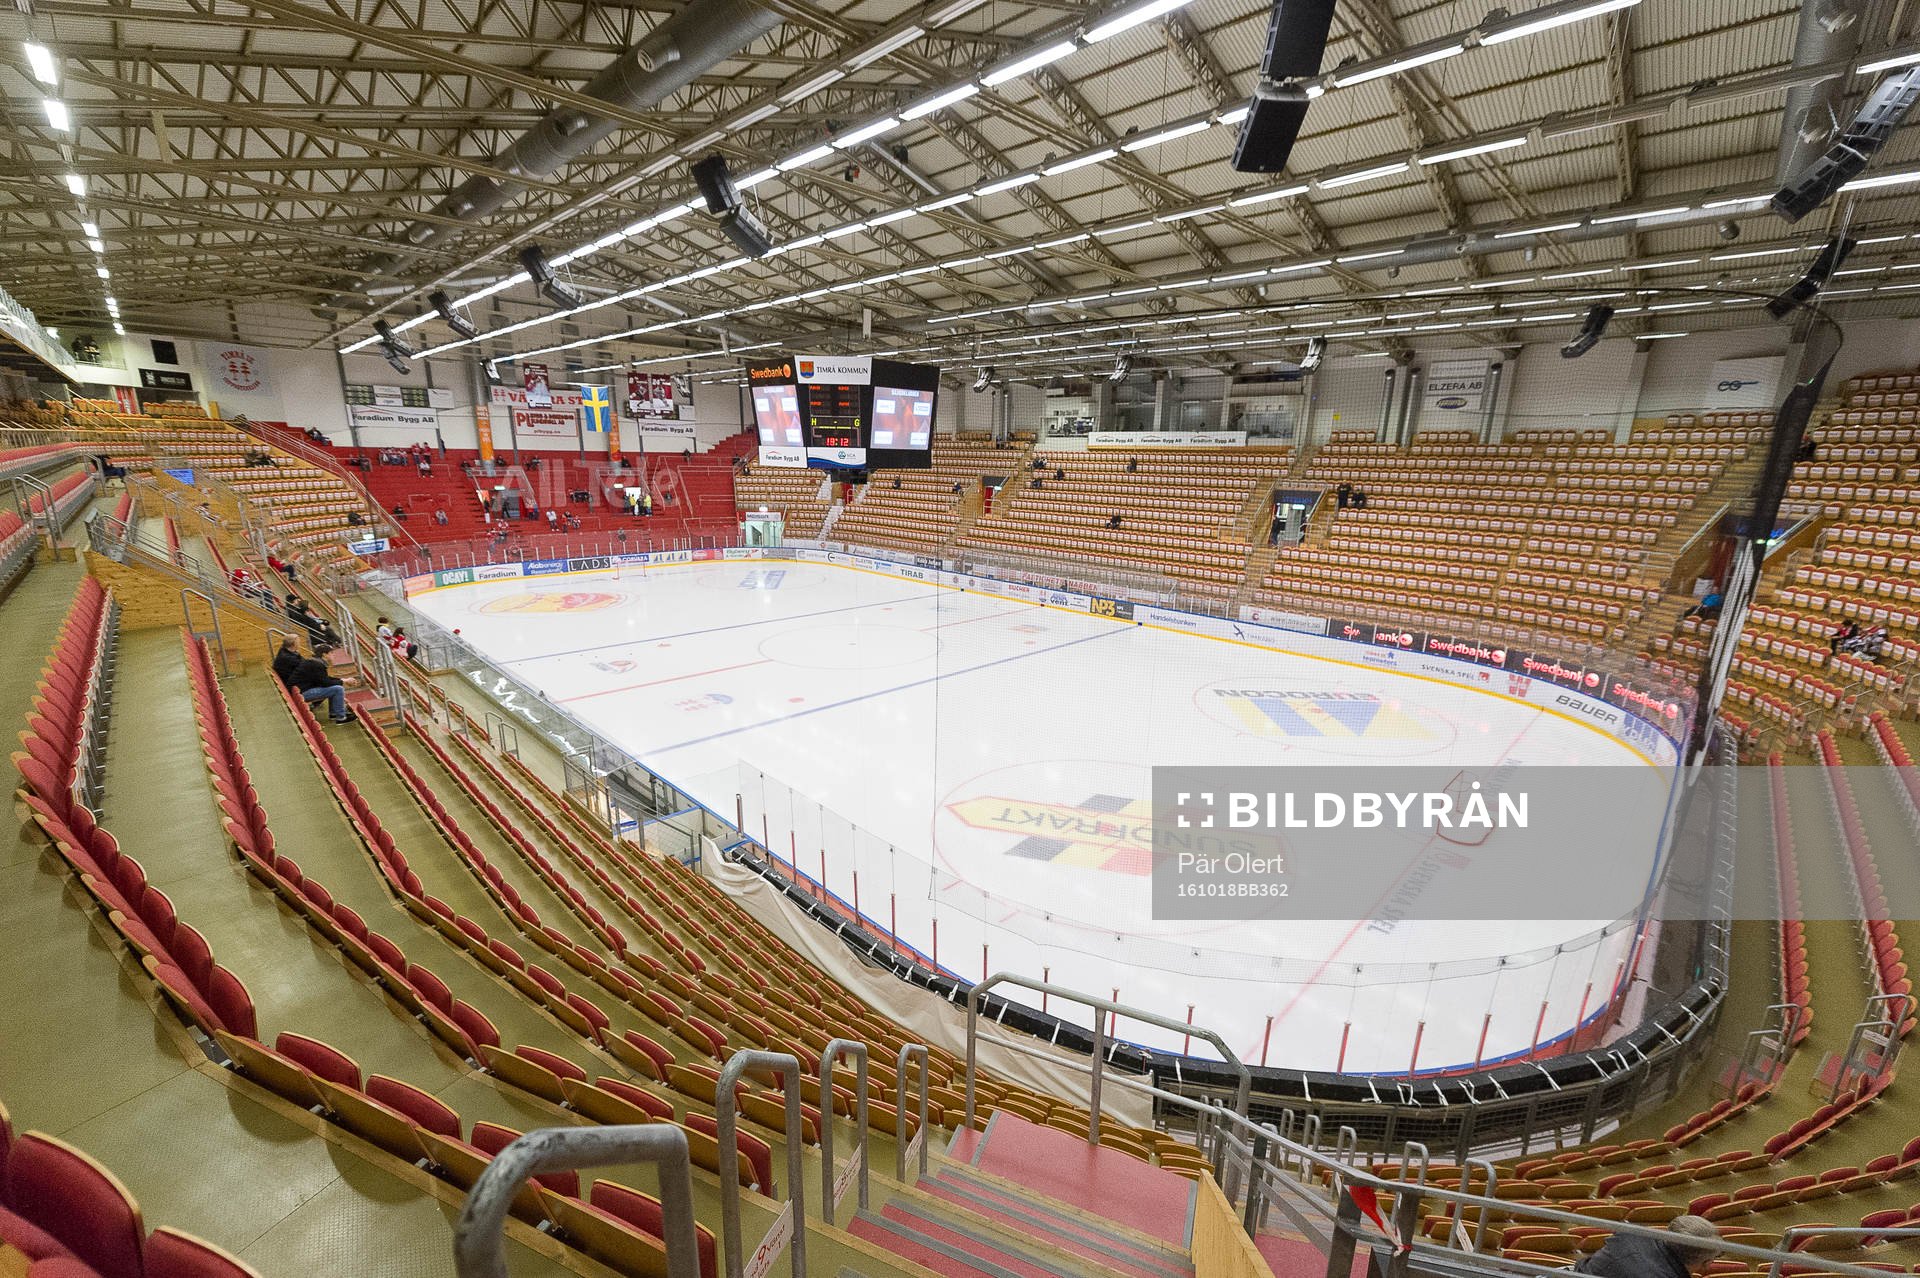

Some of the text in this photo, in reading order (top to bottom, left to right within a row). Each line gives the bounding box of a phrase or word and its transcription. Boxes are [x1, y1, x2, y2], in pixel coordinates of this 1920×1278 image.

[751, 366, 784, 379] Swedbank
[817, 366, 836, 374] TIMRÅ
[1468, 382, 1482, 390] AB
[352, 413, 435, 424] Faradium Bygg AB
[811, 418, 860, 427] H G
[571, 558, 608, 571] LADS
[479, 570, 517, 579] Faradium
[900, 569, 924, 579] TIRAB
[1091, 598, 1115, 617] NP3
[1150, 613, 1197, 628] Handelsbanken
[1429, 639, 1491, 659] Swedbank
[1421, 664, 1455, 676] SVENSKA
[1523, 657, 1583, 682] Swedbank
[1213, 688, 1381, 701] EUROCON
[1612, 683, 1666, 713] Swedbank
